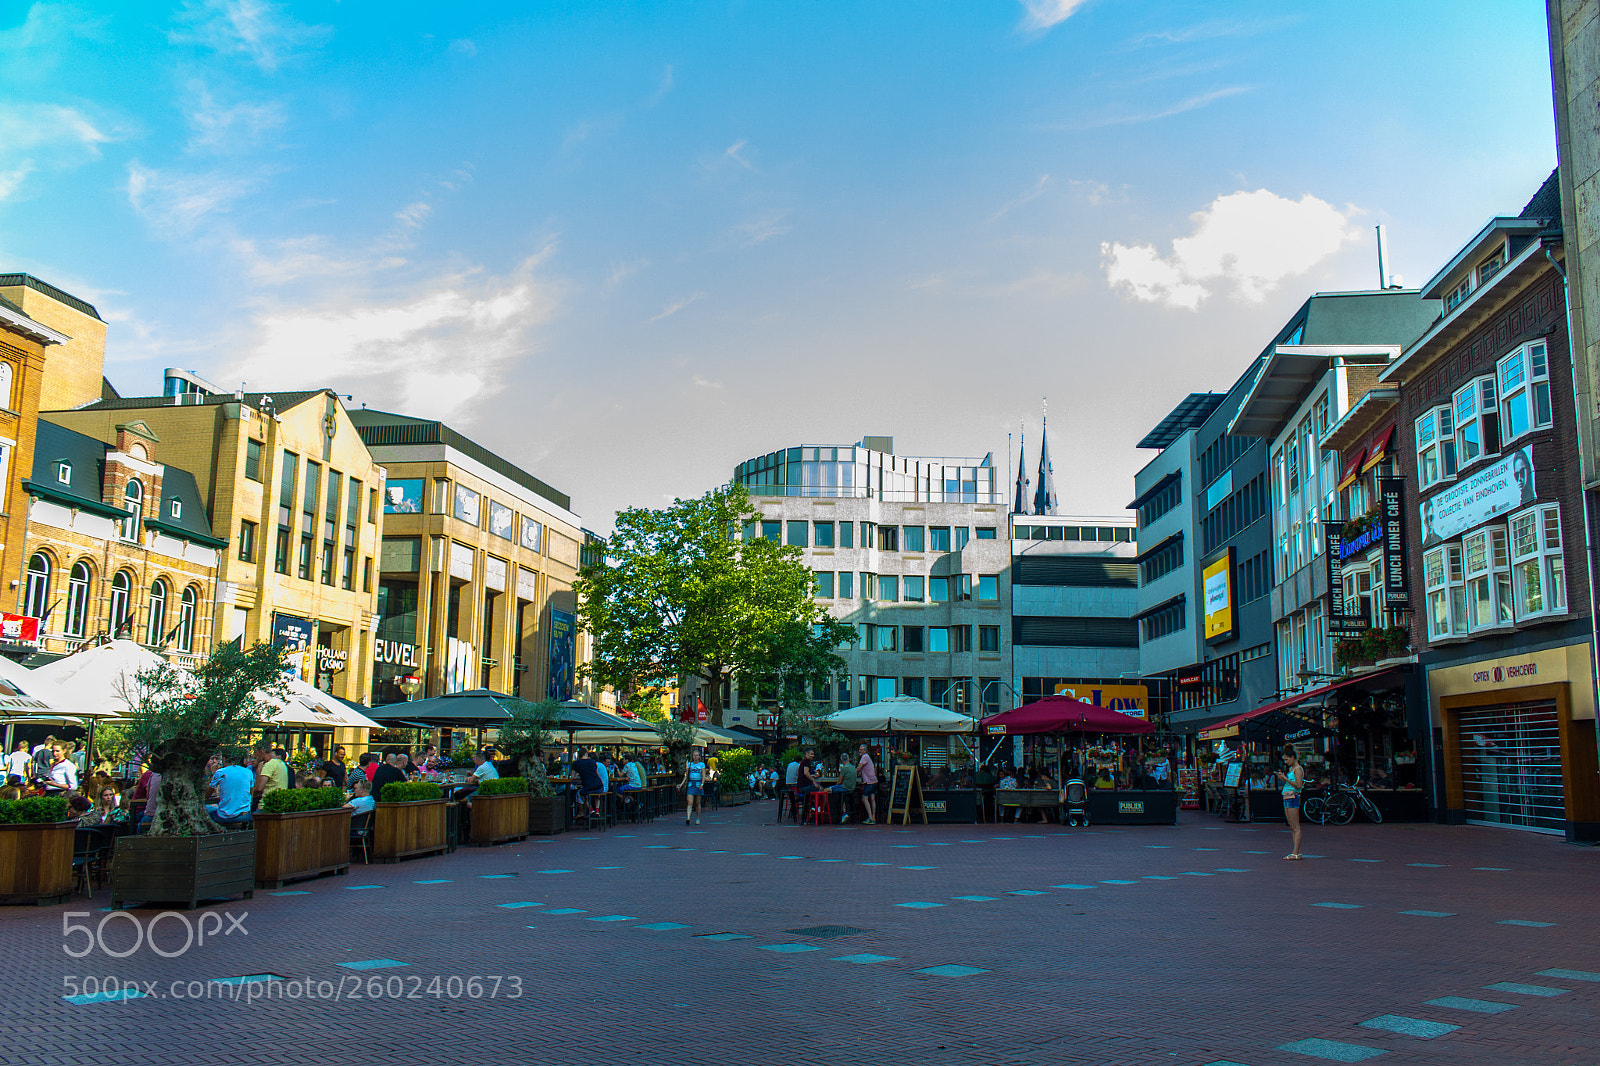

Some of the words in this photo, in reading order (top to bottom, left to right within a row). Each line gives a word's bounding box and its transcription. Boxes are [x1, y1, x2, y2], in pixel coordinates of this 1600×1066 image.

[1436, 497, 1444, 507] DE
[1444, 483, 1469, 504] GROOTSTE
[1469, 462, 1509, 490] ZONNEBRILLEN
[1384, 492, 1399, 516] CAFÉ
[1438, 501, 1462, 520] COLLECTIE
[1463, 494, 1474, 507] VAN
[1328, 533, 1341, 556] CAFÉ
[1387, 520, 1401, 551] DINER
[1331, 558, 1342, 585] DINER
[1389, 555, 1403, 588] LUNCH
[1332, 588, 1343, 616] LUNCH
[1343, 620, 1366, 628] PUBLIEK
[316, 643, 348, 660] HOLLAND
[320, 658, 344, 671] CASINO
[1473, 670, 1490, 683] OPTIEK
